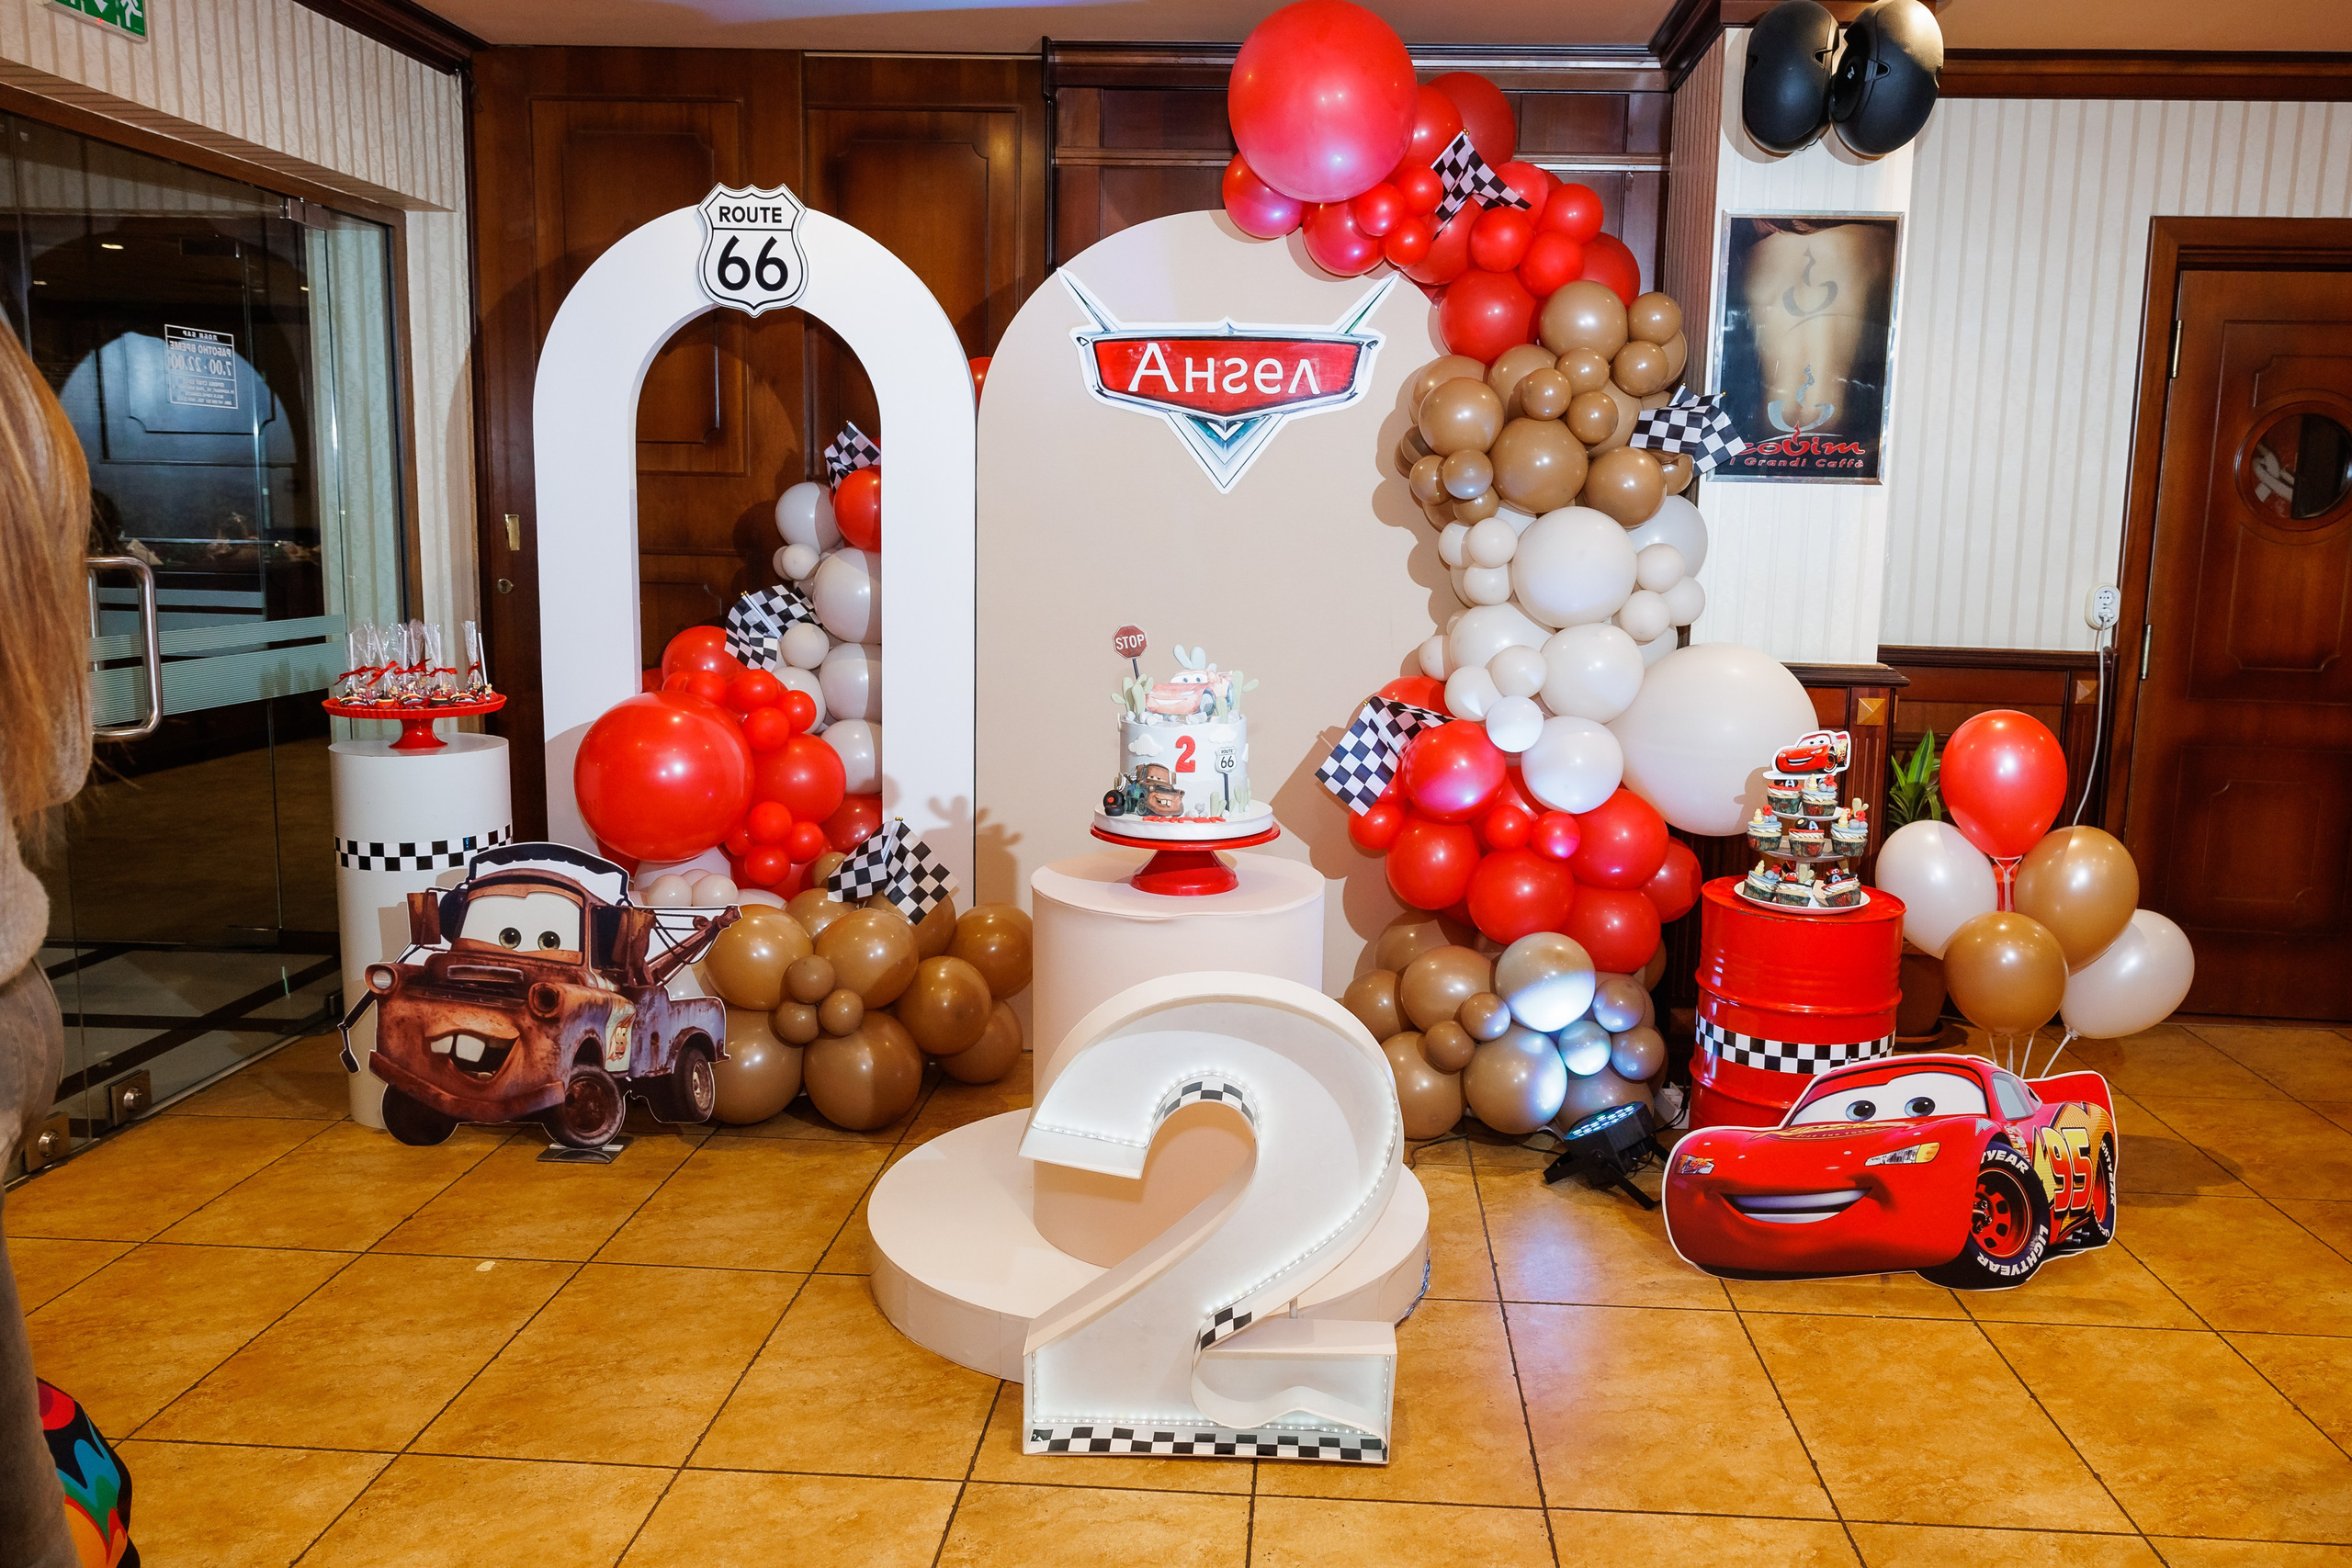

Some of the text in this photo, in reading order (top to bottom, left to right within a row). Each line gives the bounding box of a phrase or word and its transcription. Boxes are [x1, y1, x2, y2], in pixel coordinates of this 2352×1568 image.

[718, 206, 782, 223] ROUTE
[718, 234, 788, 291] 66
[1127, 342, 1320, 394] Ангел
[1744, 457, 1807, 467] Grandi
[1815, 458, 1864, 468] Caffè
[1115, 633, 1145, 651] STOP
[1175, 735, 1196, 773] 2
[1220, 755, 1234, 769] 66
[1687, 1157, 1714, 1171] 95
[2041, 1126, 2094, 1213] 95
[1018, 971, 1405, 1464] 2
[1976, 1224, 2050, 1277] LIGHTYEAR
